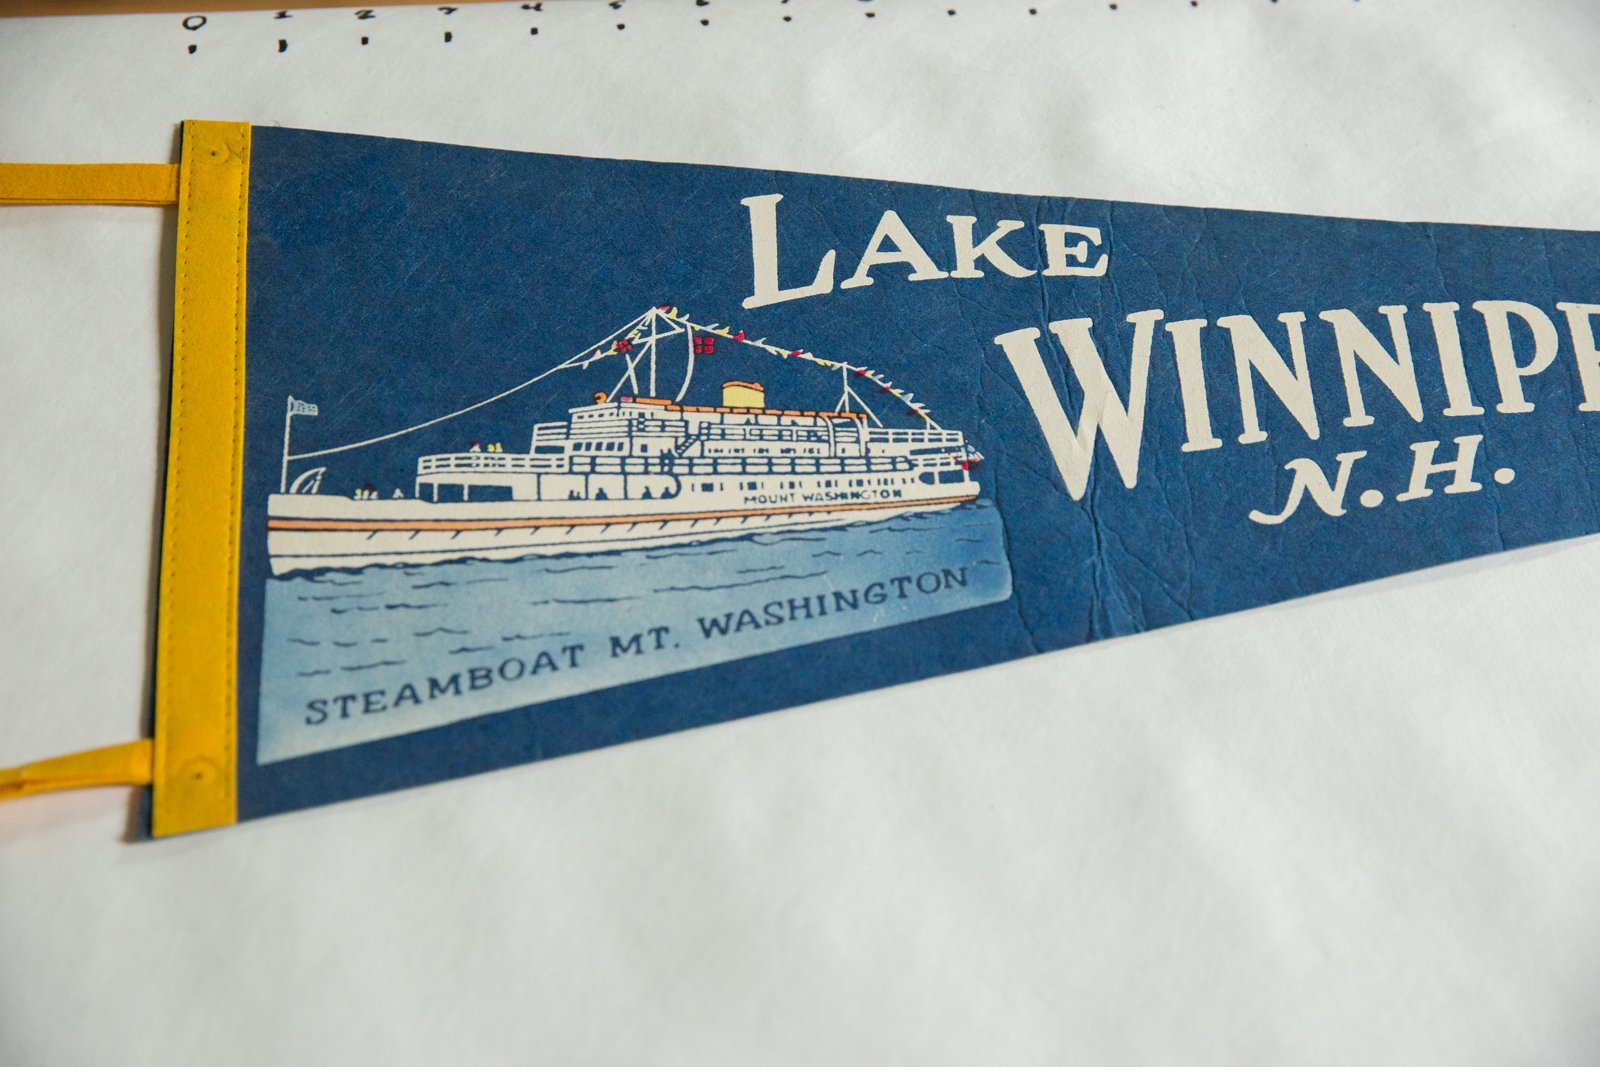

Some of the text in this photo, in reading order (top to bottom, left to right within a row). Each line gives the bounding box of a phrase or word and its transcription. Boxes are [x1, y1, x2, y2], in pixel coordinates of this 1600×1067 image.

[741, 193, 1109, 310] LAKE
[743, 488, 903, 506] MOUNT WASHINGTON
[1249, 434, 1516, 526] N.H.
[305, 566, 969, 726] STEAMBOAT MT. WASHINGTON
